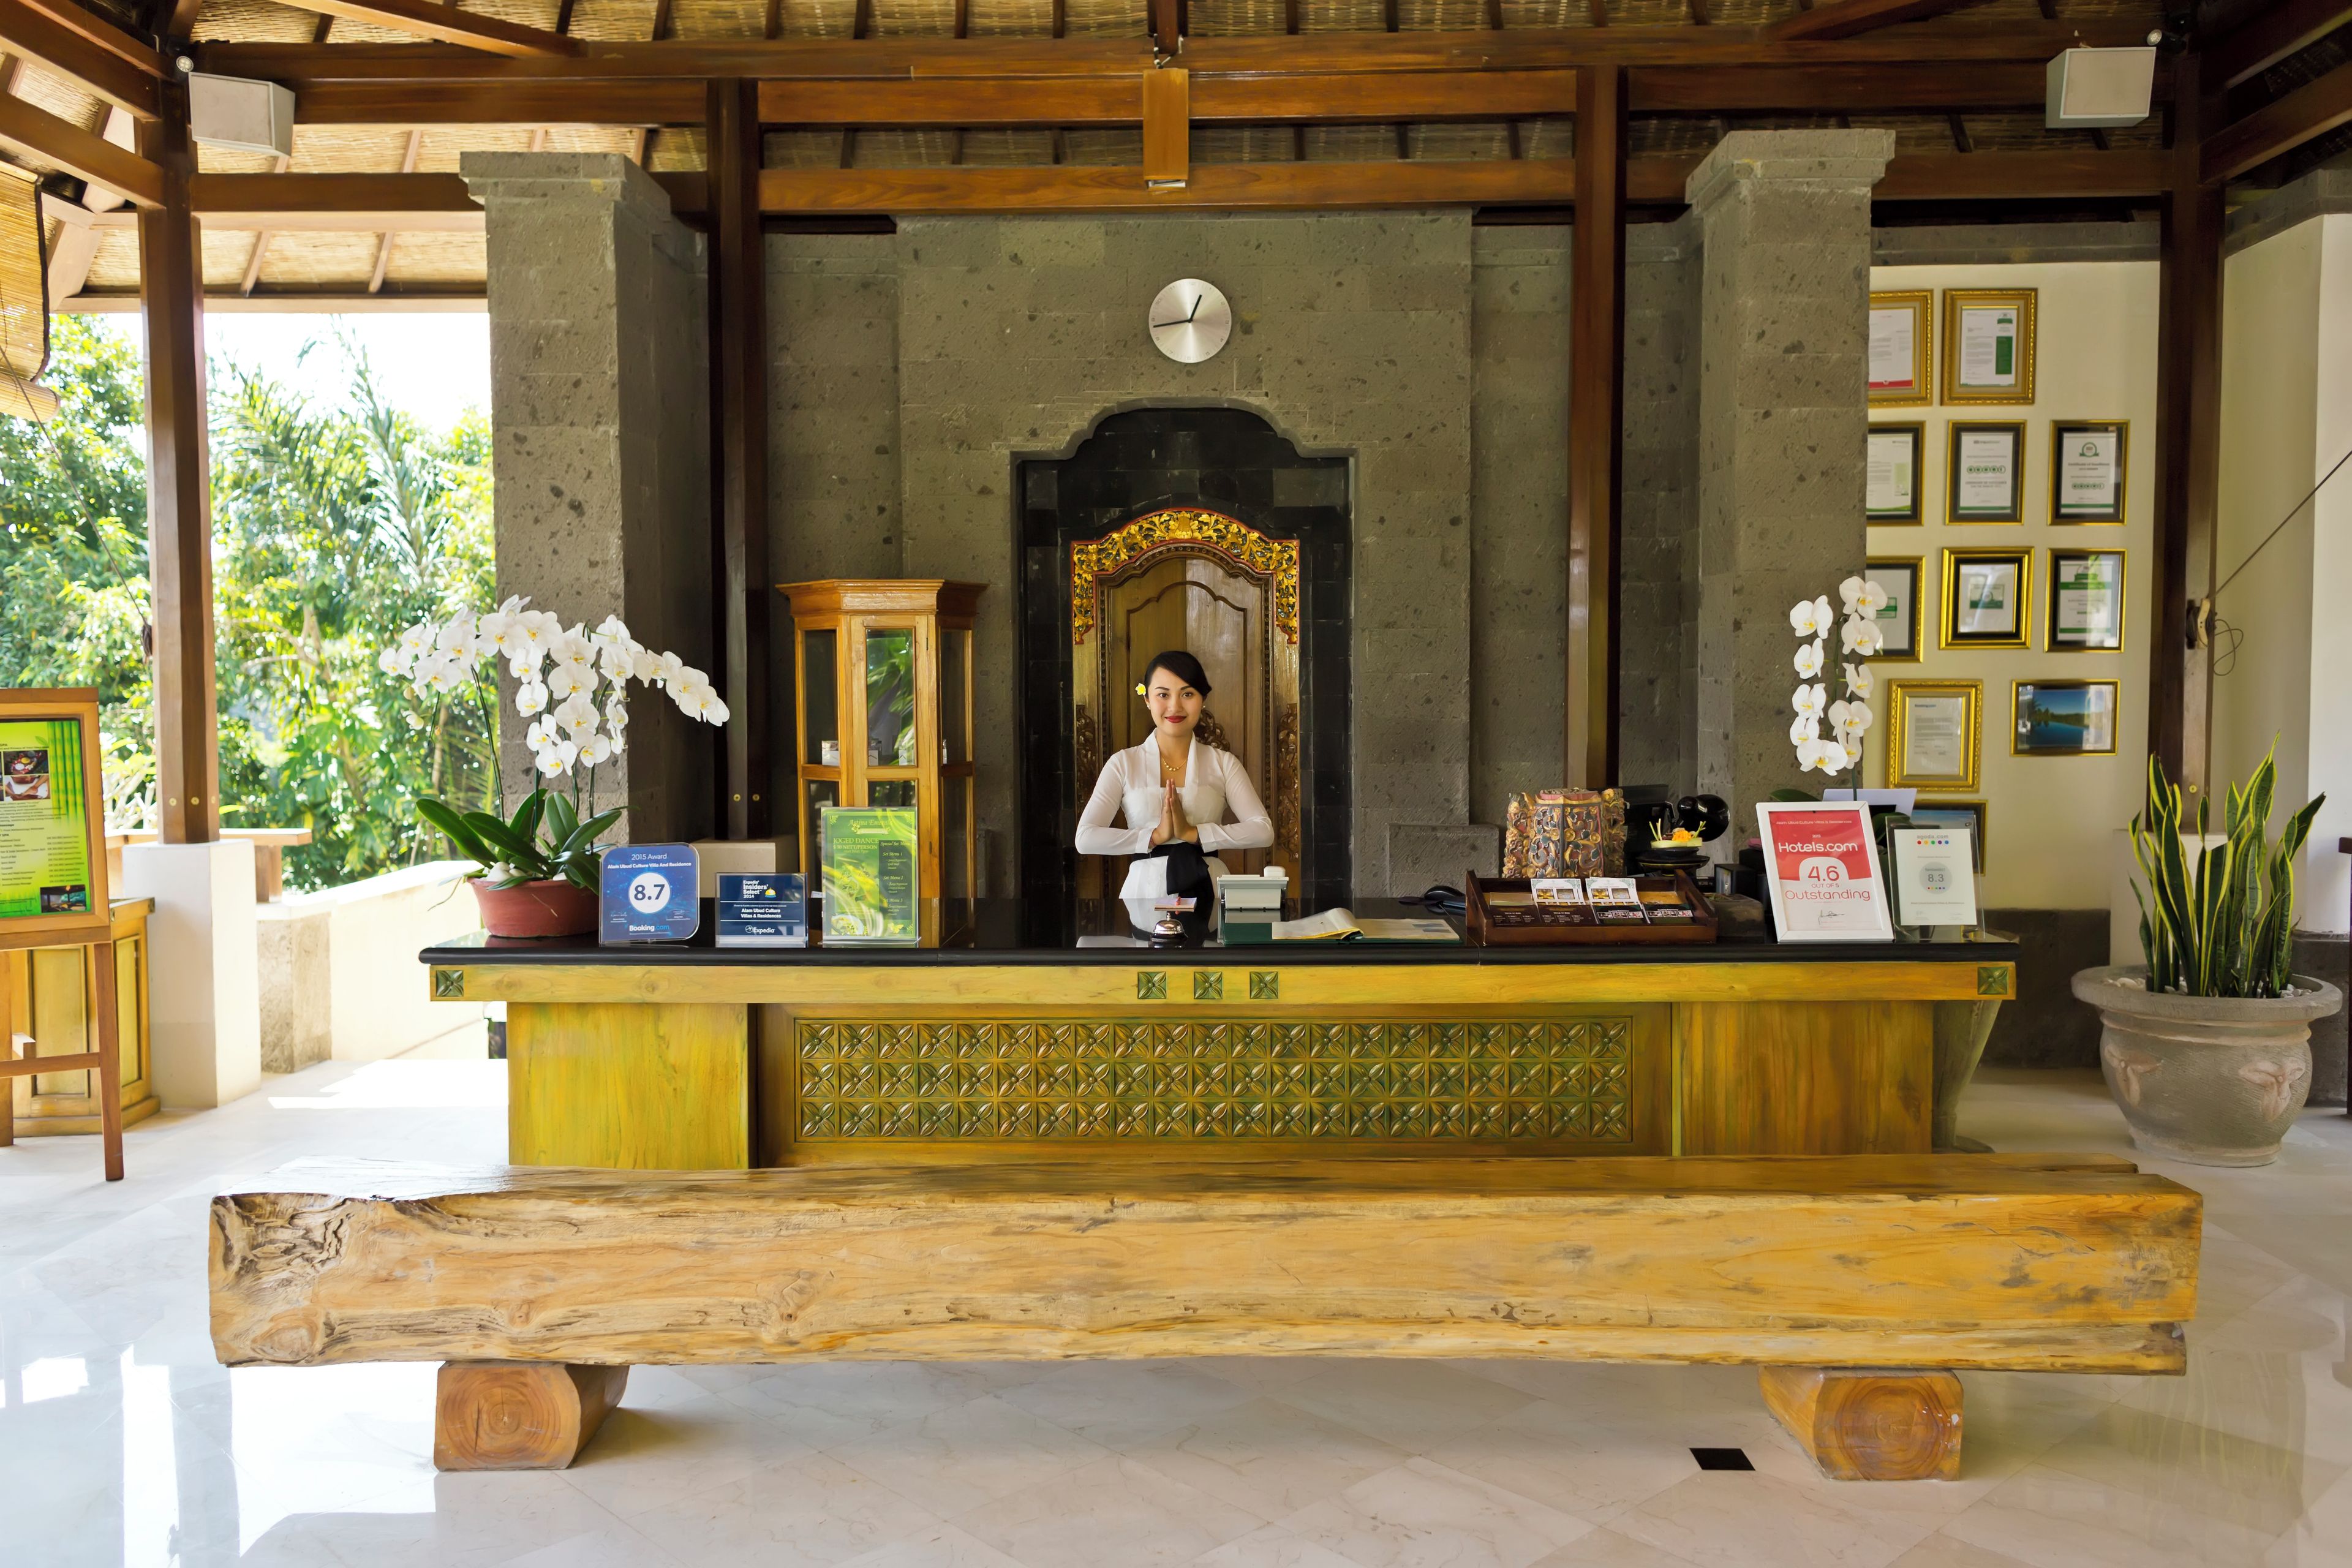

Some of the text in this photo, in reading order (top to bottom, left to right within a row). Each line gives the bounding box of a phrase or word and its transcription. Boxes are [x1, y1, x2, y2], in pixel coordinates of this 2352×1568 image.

[1778, 842, 1858, 853] Hotels.com
[1808, 865, 1840, 881] 4.6
[1928, 873, 1944, 883] 8.3
[634, 884, 665, 901] 8.7
[1785, 889, 1871, 902] Outstanding
